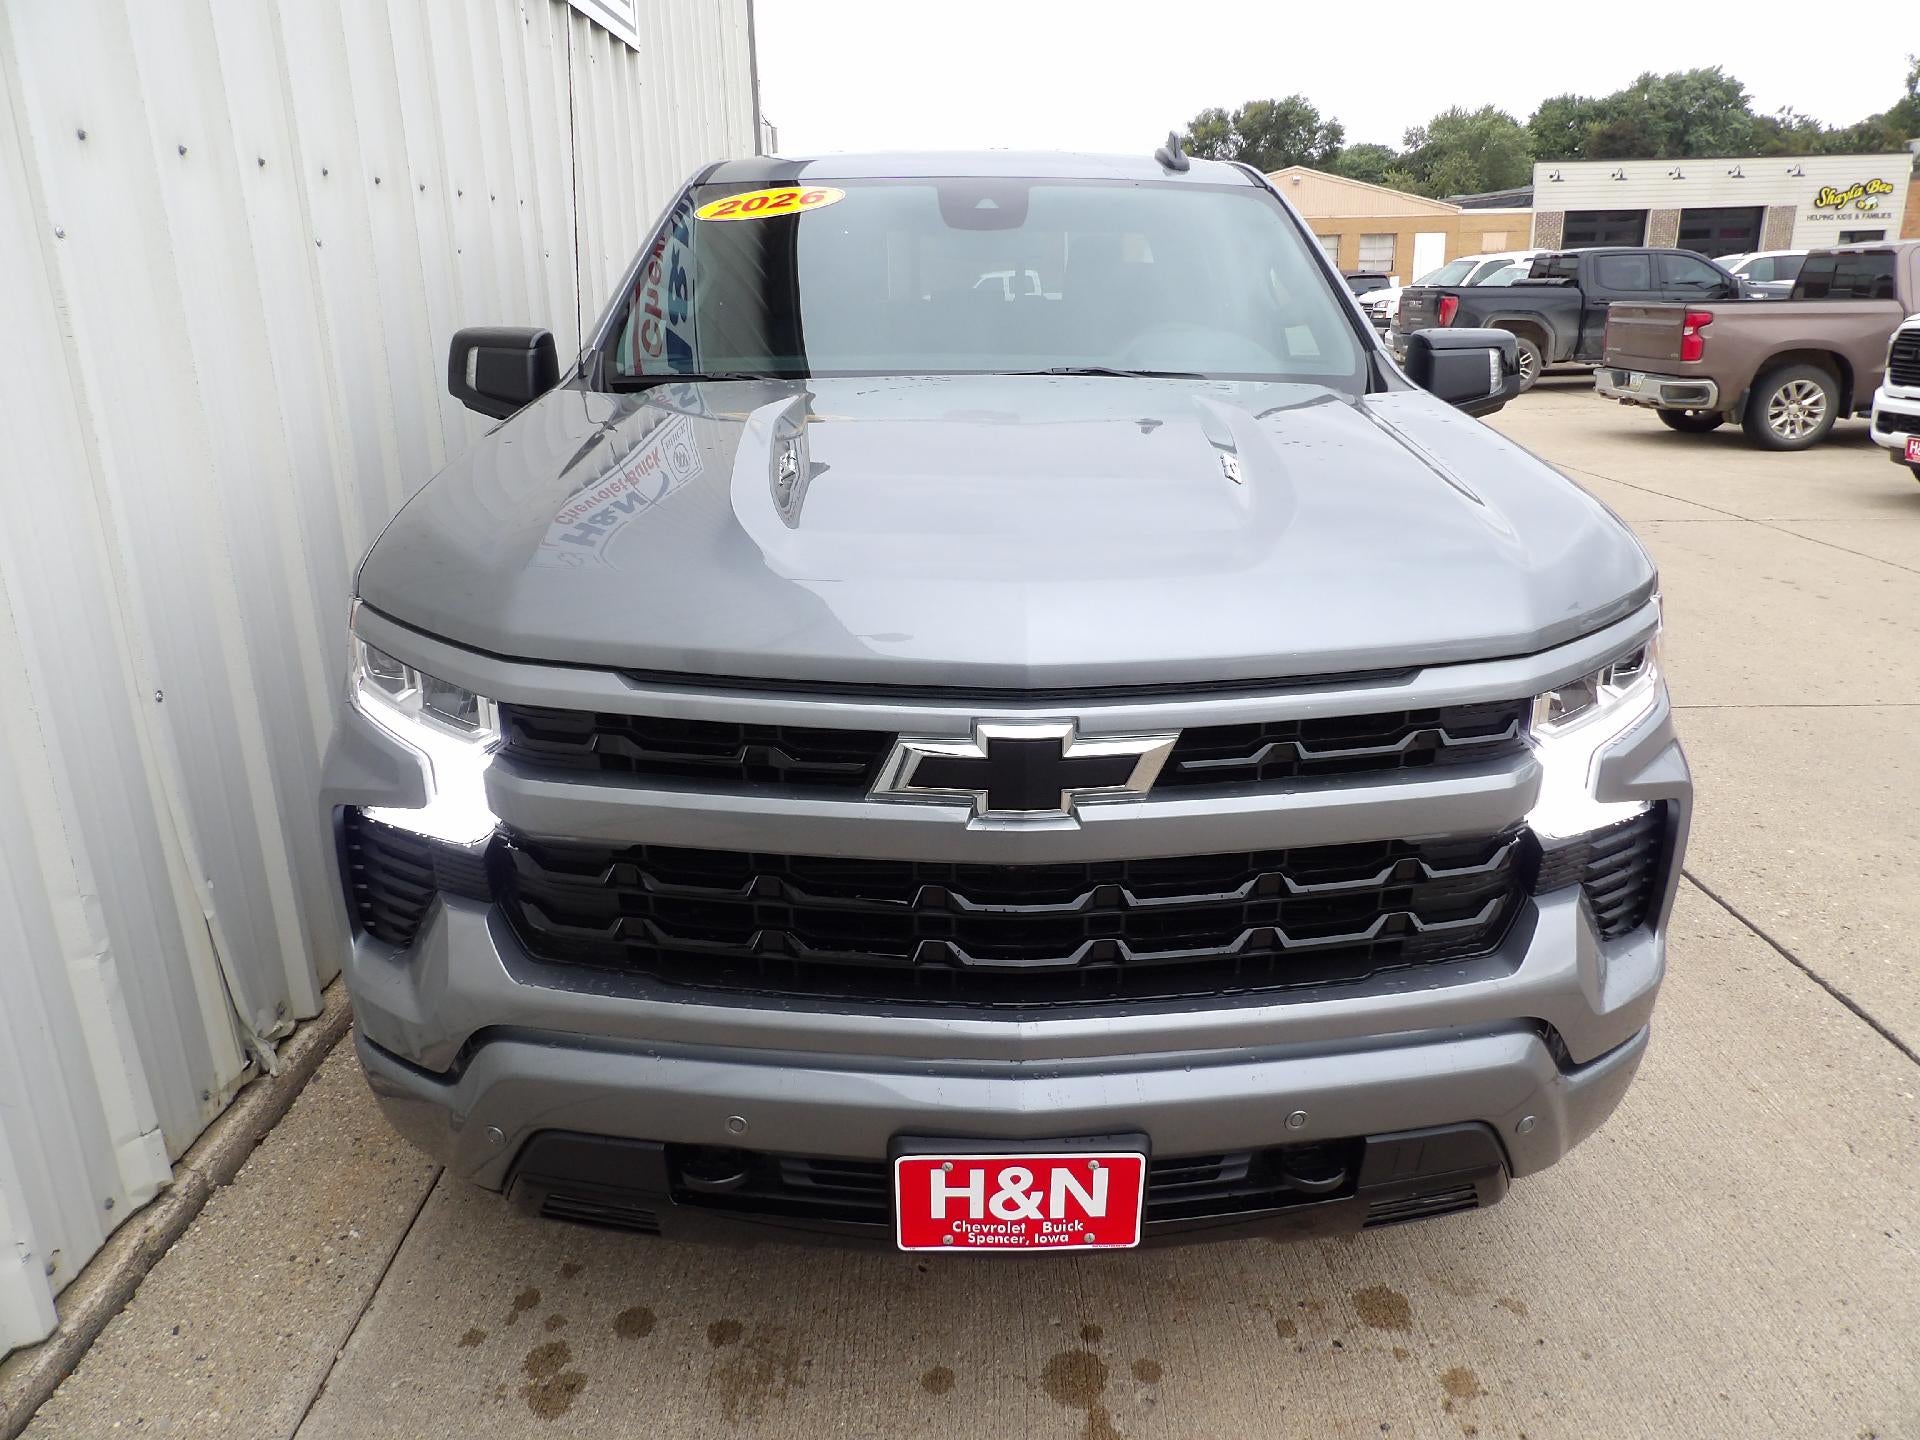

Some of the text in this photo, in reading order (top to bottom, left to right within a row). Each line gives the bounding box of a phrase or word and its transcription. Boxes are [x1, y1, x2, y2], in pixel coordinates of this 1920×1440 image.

[710, 190, 828, 218] 2026
[1814, 178, 1893, 210] Shayla Bee
[1806, 213, 1834, 221] HELPING
[1854, 212, 1860, 220] &
[1862, 212, 1892, 220] FAMILIES
[930, 1166, 1109, 1220] H&N
[952, 1219, 1084, 1234] Chevrolet Buick
[967, 1232, 1069, 1246] Spencer, Iowa
